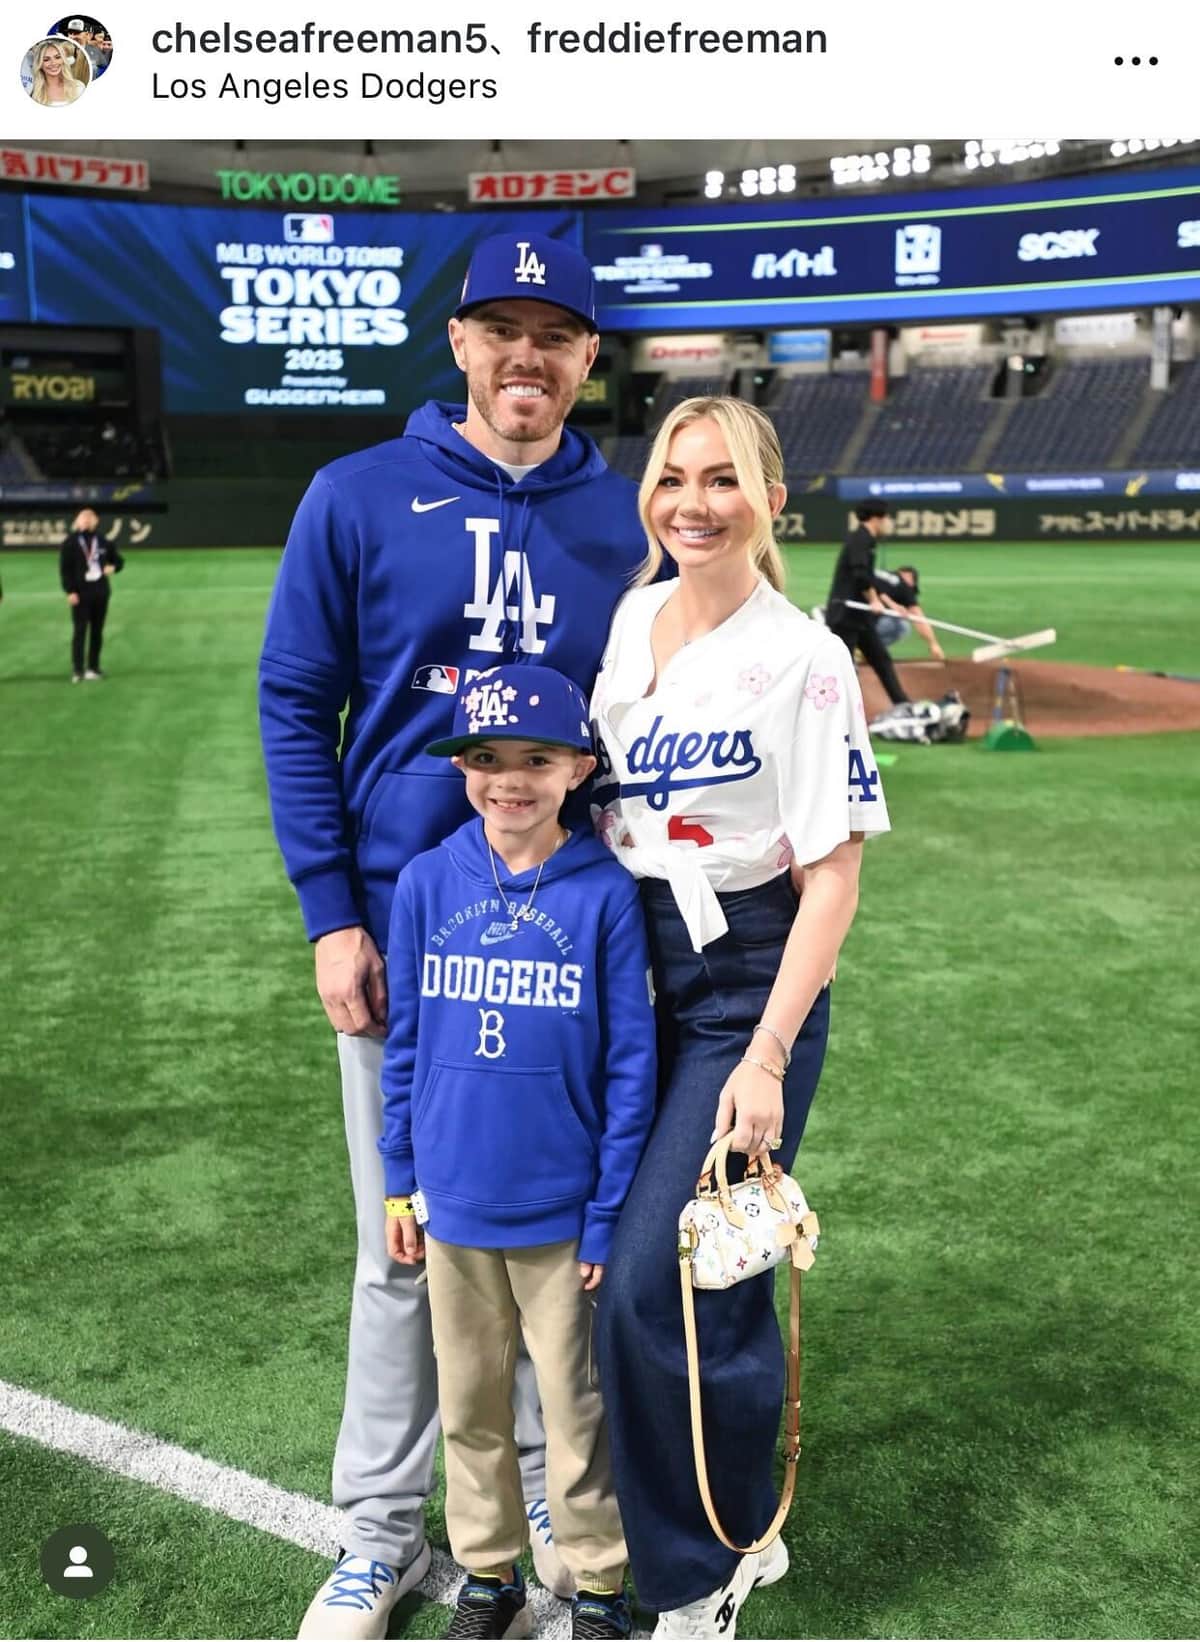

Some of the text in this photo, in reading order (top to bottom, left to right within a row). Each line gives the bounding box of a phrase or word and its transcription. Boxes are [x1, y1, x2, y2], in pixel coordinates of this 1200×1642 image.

[215, 170, 401, 205] TOKYO DOME
[474, 168, 630, 199] オロナミンC
[215, 242, 264, 265] MLB
[263, 244, 345, 267] WORLD
[513, 241, 546, 286] LA
[1016, 228, 1101, 262] SCSK
[219, 266, 403, 307] TOKYO
[218, 304, 410, 346] SERIES
[283, 348, 345, 372] 2025
[11, 373, 95, 401] RYOBI
[463, 517, 556, 655] LA
[477, 684, 509, 727] LA
[431, 898, 575, 957] BROOKLYN BASEBALL
[421, 953, 584, 1009] DODGERS
[474, 1008, 507, 1059] B
